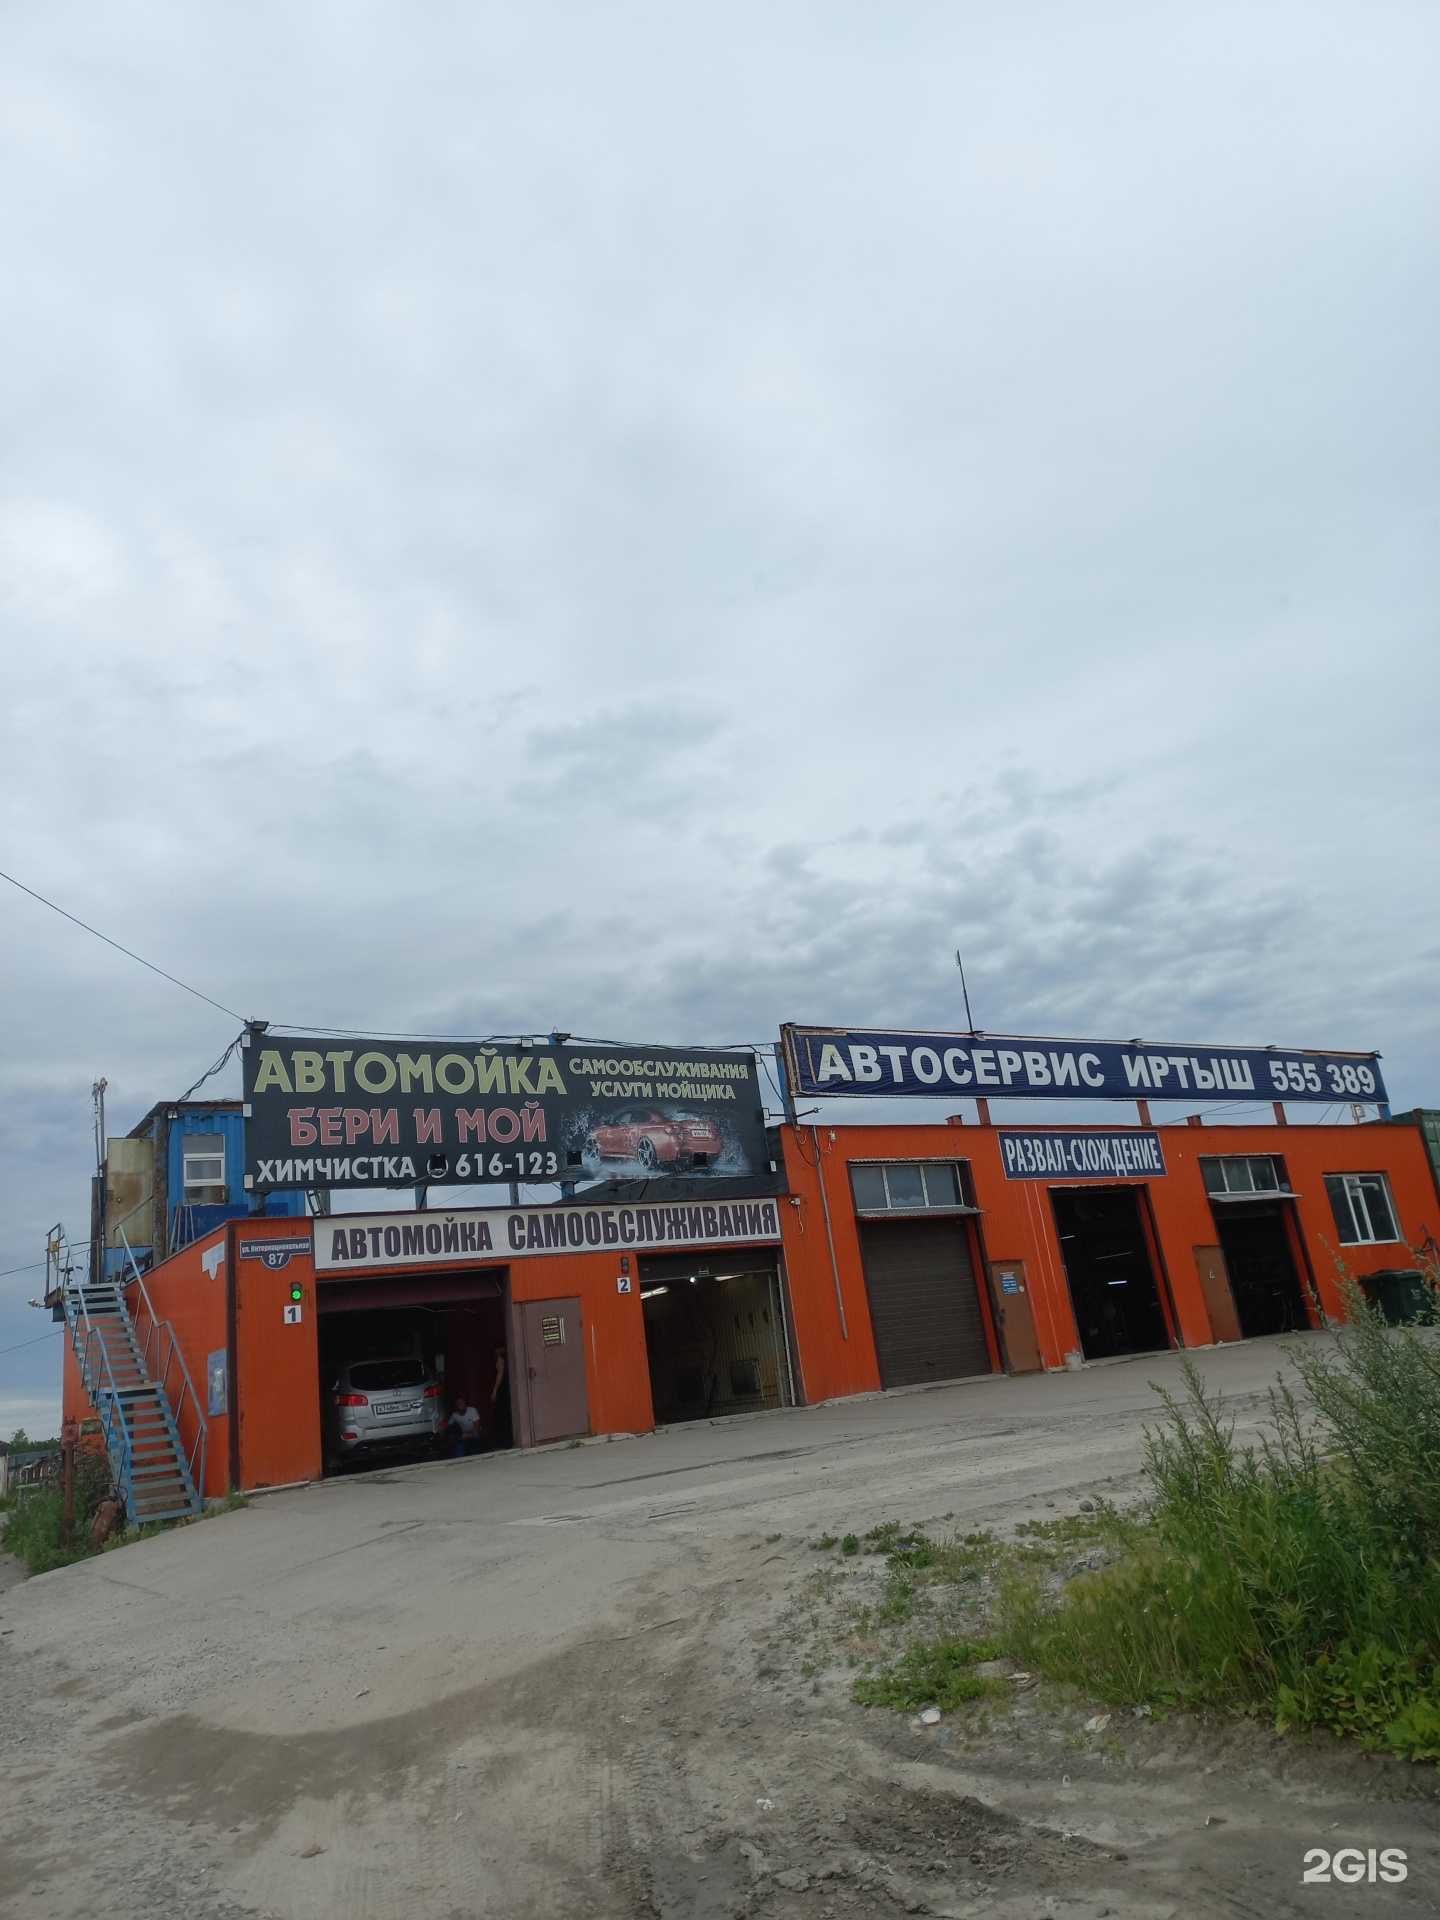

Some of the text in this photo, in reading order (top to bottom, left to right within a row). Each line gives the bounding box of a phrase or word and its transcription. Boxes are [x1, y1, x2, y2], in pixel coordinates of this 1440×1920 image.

[253, 1047, 567, 1095] АВТОМОЙКА
[569, 1057, 749, 1079] САМООБСЛУЖИВАНИЯ
[817, 1044, 1376, 1094] АВТОСЕРВИС ИРТЫШ 555 389
[590, 1080, 736, 1101] УСЛУГИ МОЙЩИКА
[287, 1100, 547, 1146] БЕРИ И МОЙ
[256, 1152, 558, 1183] ХИМЧИСТКА 616-123
[1004, 1138, 1161, 1177] РАЗВАЛ-СХОЖДЕНИЕ
[331, 1203, 777, 1261] АВТОМОЙКА САМООБСЛУЖИВАНИЯ
[268, 1253, 284, 1265] 87
[620, 1279, 629, 1291] 2
[287, 1307, 297, 1322] 1
